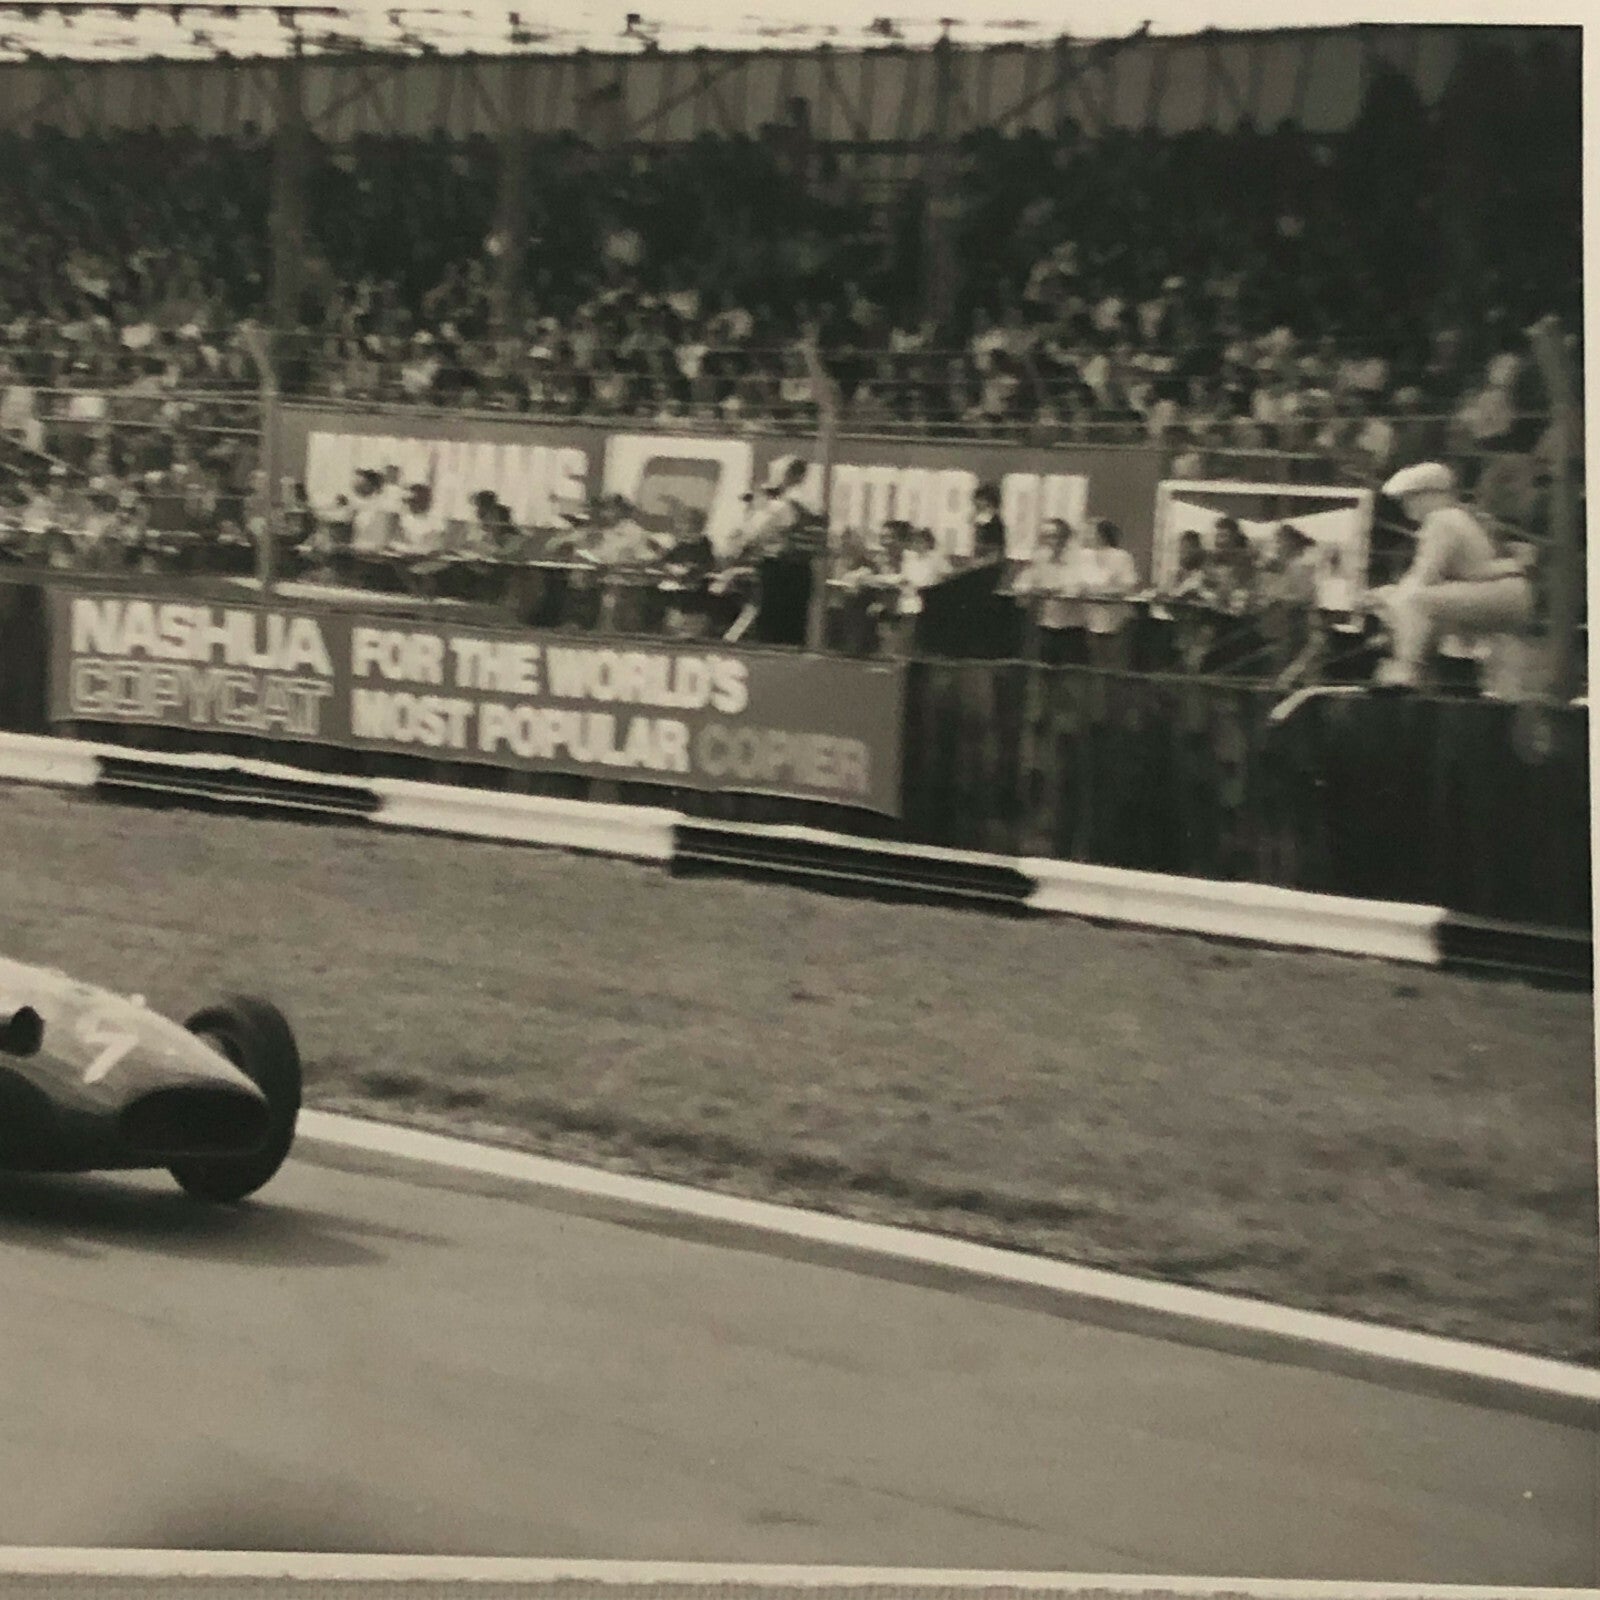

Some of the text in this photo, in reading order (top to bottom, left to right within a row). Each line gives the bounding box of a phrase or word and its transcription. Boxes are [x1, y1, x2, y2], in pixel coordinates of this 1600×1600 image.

[71, 598, 334, 676] NASHUA
[351, 627, 443, 684] FOR
[451, 638, 541, 694] THE
[70, 657, 334, 736] COPYCAT
[351, 688, 870, 794] MOST POPULAR COPIER
